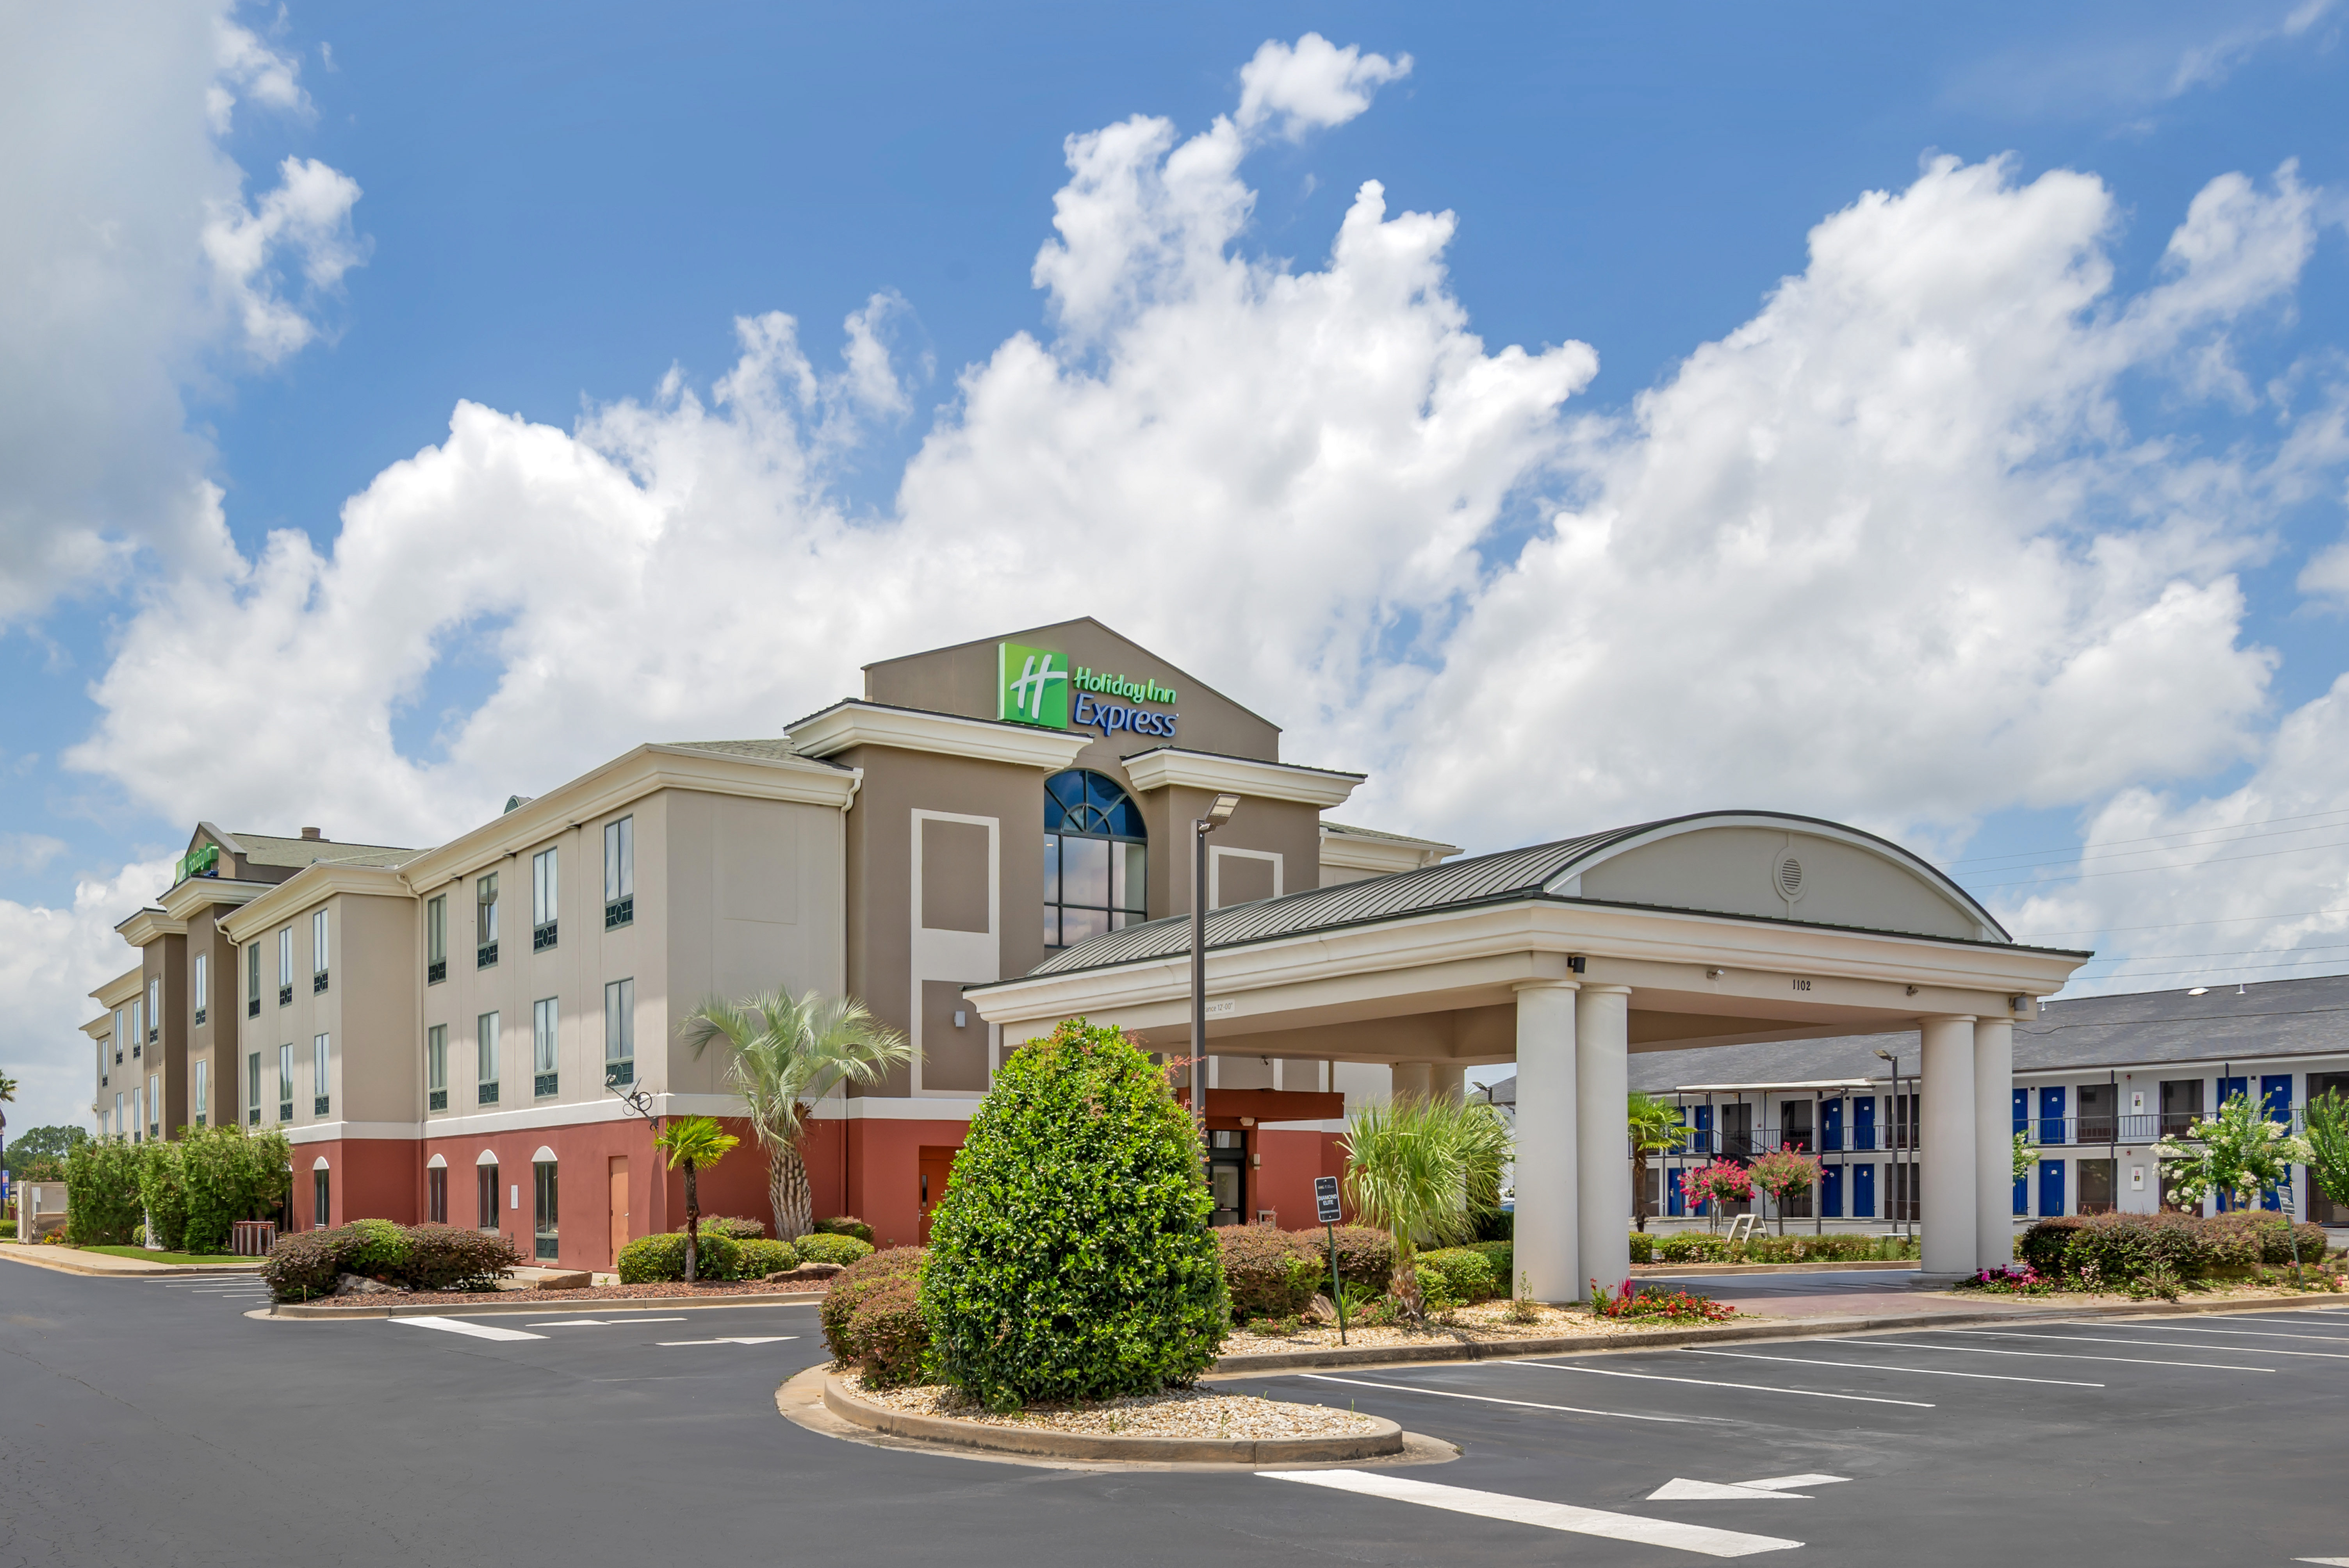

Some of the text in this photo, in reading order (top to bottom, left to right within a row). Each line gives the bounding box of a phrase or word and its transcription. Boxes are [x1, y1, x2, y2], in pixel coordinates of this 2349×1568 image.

[1073, 666, 1177, 704] Holiday Inn
[1073, 693, 1177, 738] Express
[1793, 979, 1811, 991] 1102
